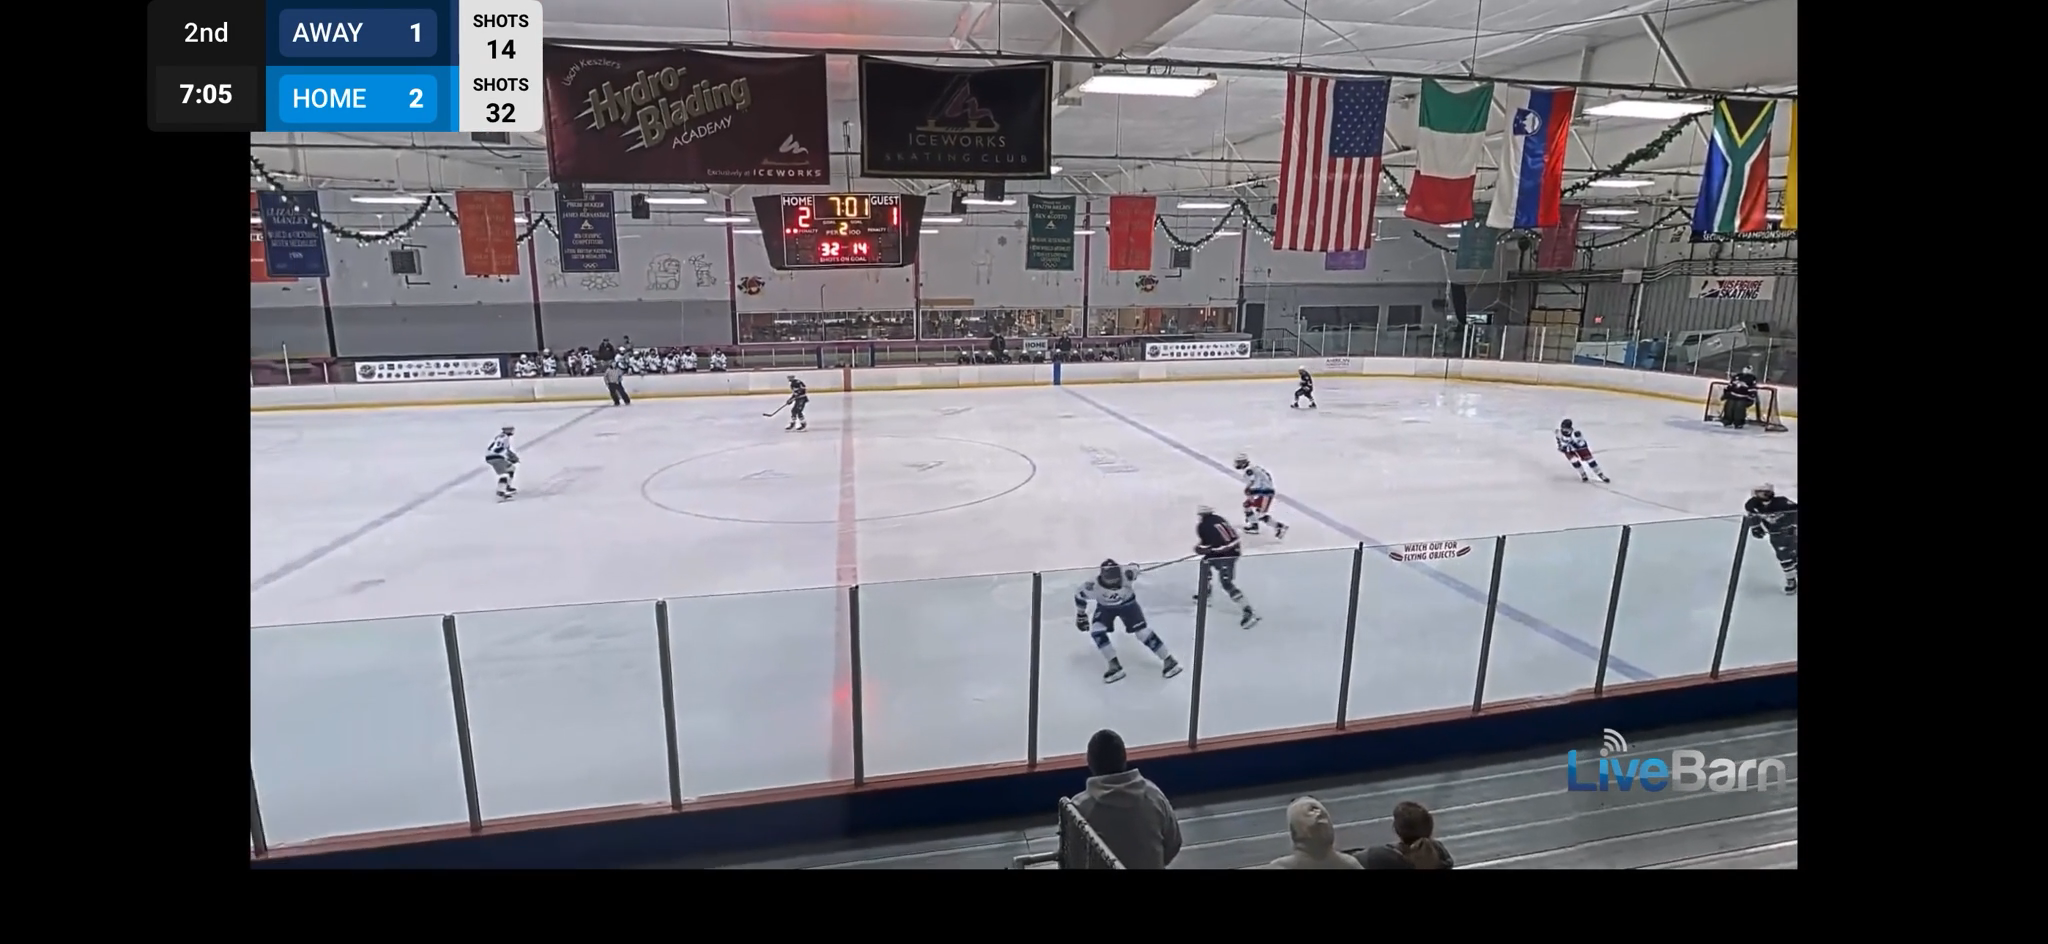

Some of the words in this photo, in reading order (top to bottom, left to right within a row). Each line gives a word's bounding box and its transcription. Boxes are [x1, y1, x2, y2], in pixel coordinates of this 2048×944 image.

[588, 66, 687, 130] Hydro-
[636, 77, 752, 149] Blading
[672, 115, 733, 149] ACADEMY
[908, 133, 1006, 147] ICEWORKS
[885, 152, 971, 163] SKATING
[981, 154, 1028, 164] CLUB
[753, 169, 822, 177] ICEWORKS
[783, 196, 813, 206] HOME
[828, 196, 868, 217] 7:01
[870, 196, 899, 205] GUEST
[798, 207, 811, 228] 2
[892, 207, 898, 225] 1
[821, 242, 840, 256] 32
[853, 242, 867, 254] 14
[1719, 289, 1760, 299] SKATING
[1404, 543, 1427, 552] WATCH
[1428, 542, 1443, 551] OUT
[1444, 541, 1458, 550] FOR
[1404, 552, 1427, 562] FLYING
[1428, 550, 1456, 560] OBJECTS
